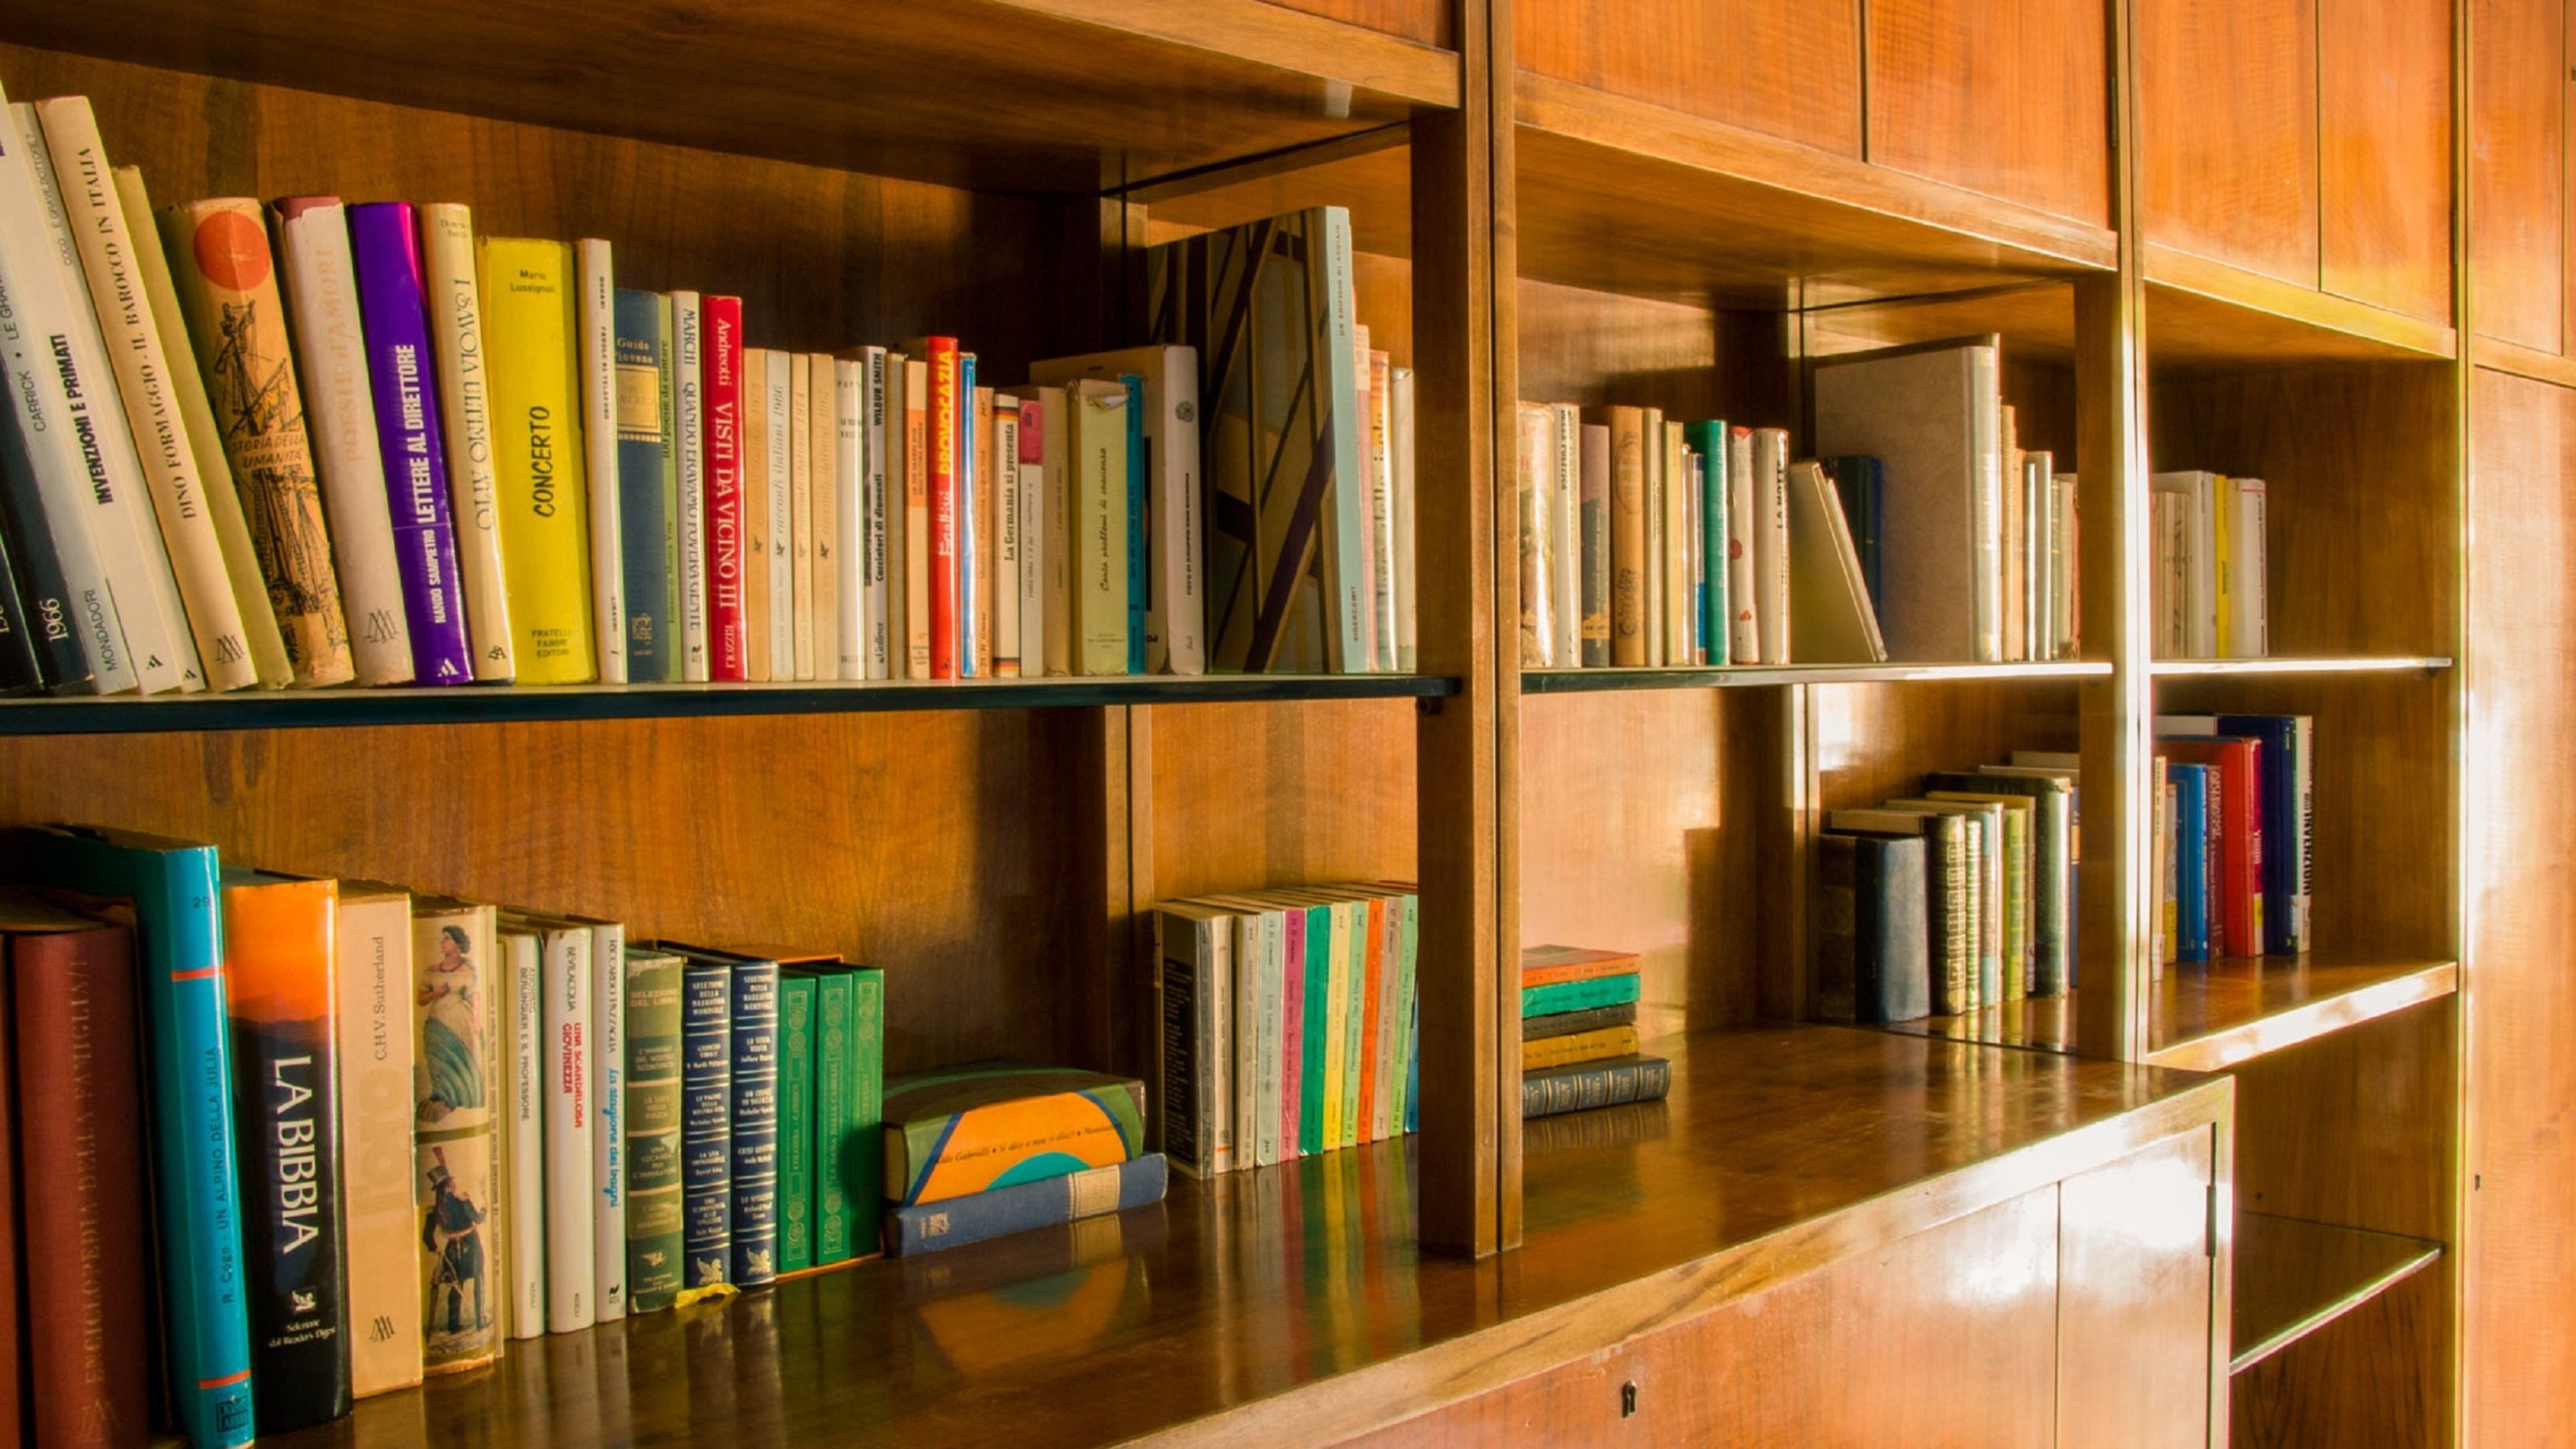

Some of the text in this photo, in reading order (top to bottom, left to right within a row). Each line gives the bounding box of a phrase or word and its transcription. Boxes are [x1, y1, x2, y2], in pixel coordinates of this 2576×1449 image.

[520, 270, 546, 280] Mario
[77, 147, 195, 519] DINO FORMAGGIO IL BAROCCO IN ITALIA
[617, 337, 650, 350] Guido
[8, 318, 46, 432] CARRICK LE
[874, 352, 883, 426] WILBUR SMITH
[49, 334, 114, 505] INVENZIONI E PRIMATI
[395, 344, 446, 624] NANDO SAMPIETRO LETTERE AL DIRETTORE
[530, 405, 556, 517] CONCERTO
[682, 308, 701, 630] MARCHI QUANDO ERAVAMO POVERA GENTE
[715, 318, 737, 608] Andreotti VISTI DA VICINO III
[1003, 424, 1017, 562] La Germania si presenta
[472, 472, 495, 531] ATTO
[874, 473, 884, 582] Cacciatori di diamanti
[39, 597, 69, 643] 1966
[84, 589, 118, 671] MONDADORI
[532, 629, 571, 639] FRATELLI
[725, 625, 736, 668] RIZZOLI
[372, 936, 386, 1014] Sutherland
[520, 967, 530, 1030] BERLINGUER
[566, 946, 577, 1011] BEVILACQUA
[204, 1047, 219, 1089] JULIA
[521, 1055, 530, 1121] PROFESSORE
[563, 1023, 573, 1094] GIOVINEZZA
[575, 1050, 584, 1128] SCANDALOSA
[208, 1096, 226, 1142] DELLA
[602, 1086, 619, 1144] stagione
[212, 1148, 227, 1203] ALPINO
[274, 1055, 319, 1254] LA BIBBIA
[610, 1146, 619, 1167] dei
[216, 1208, 229, 1230] UN
[602, 1169, 620, 1208] bagni
